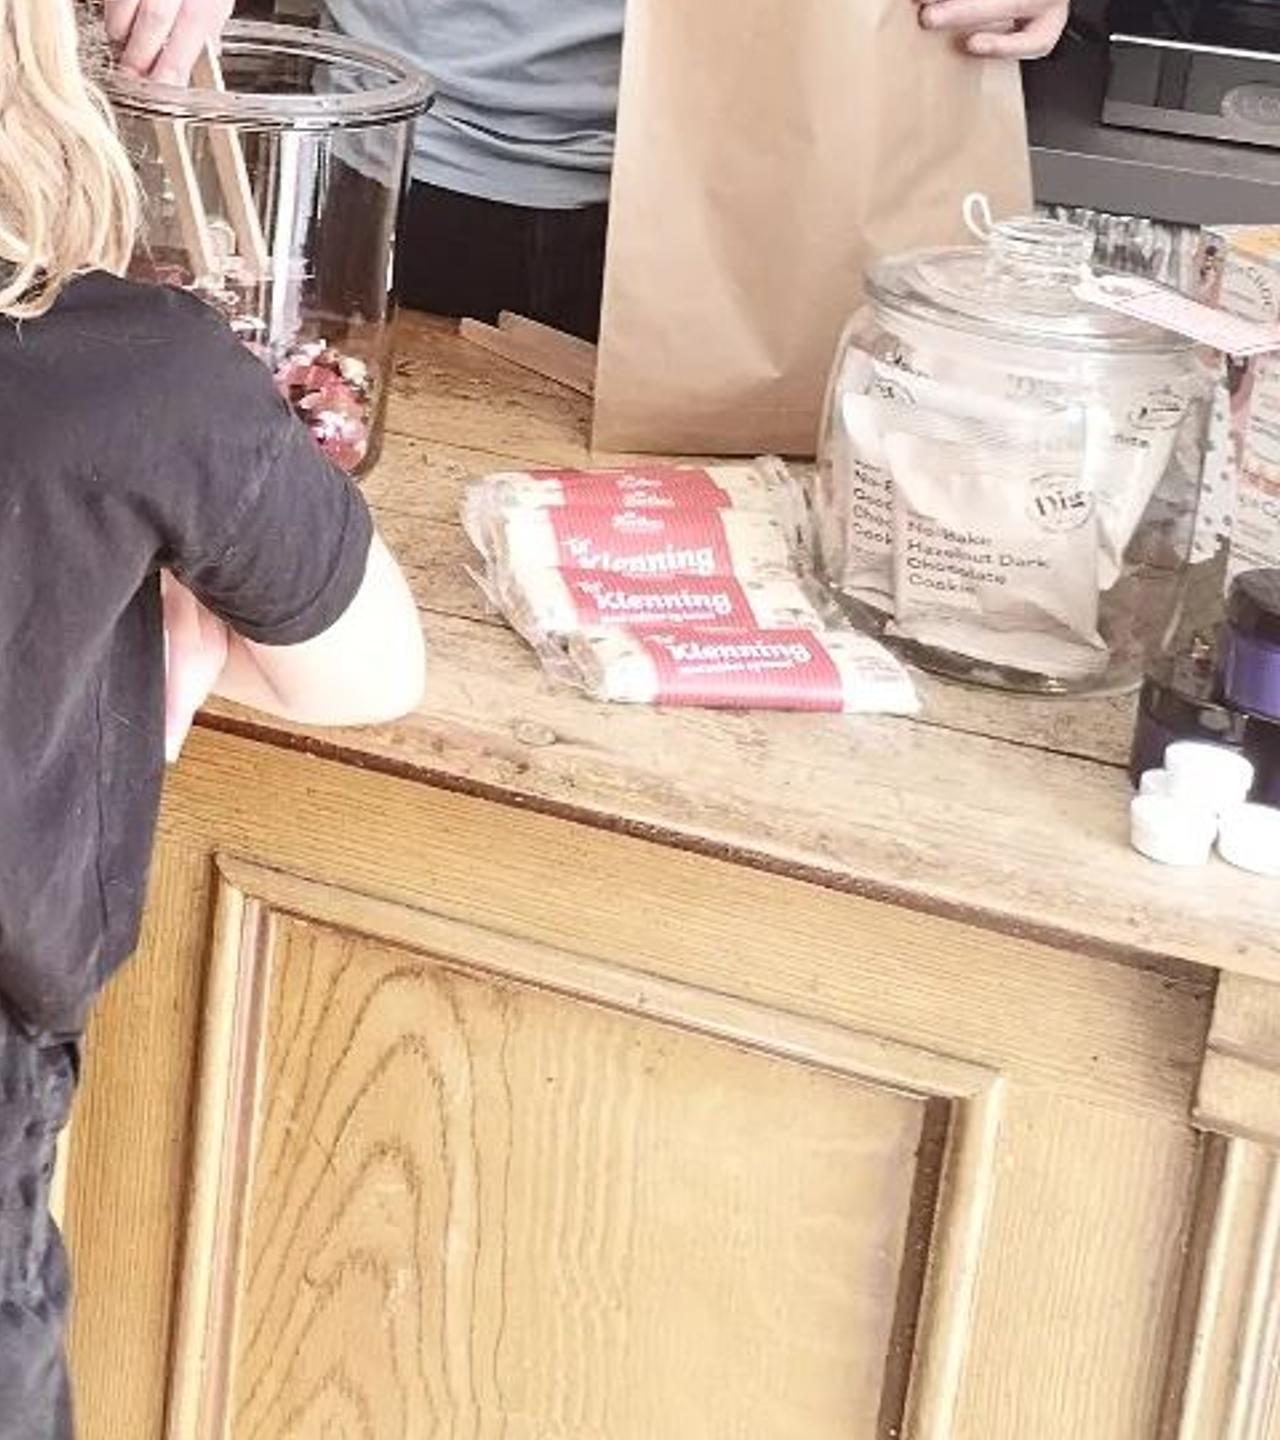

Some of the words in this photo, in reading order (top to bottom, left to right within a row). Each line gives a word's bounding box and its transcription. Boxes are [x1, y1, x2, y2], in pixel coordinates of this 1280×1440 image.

[907, 557, 1007, 585] Chocolate
[595, 589, 732, 616] Klenning
[664, 641, 813, 664] Klenning
